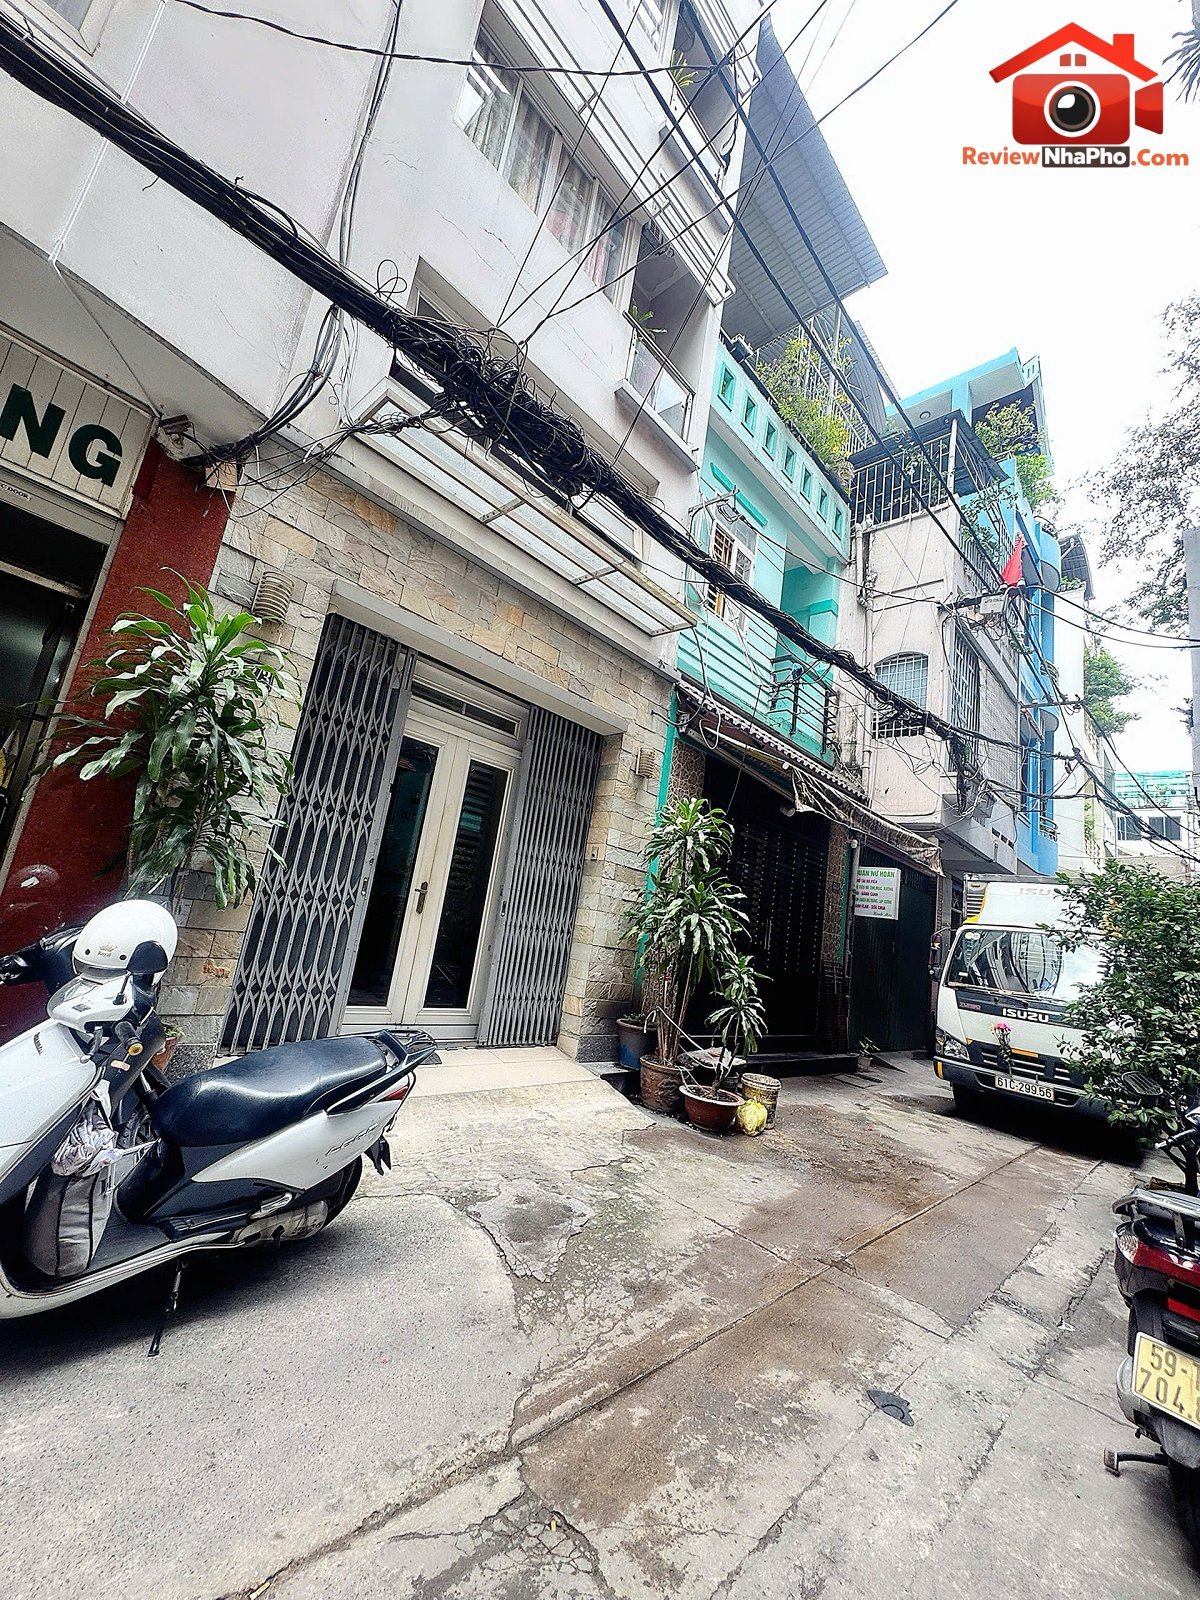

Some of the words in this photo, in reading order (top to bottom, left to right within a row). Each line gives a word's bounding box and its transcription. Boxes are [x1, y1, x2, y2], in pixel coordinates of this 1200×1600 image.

[0, 383, 123, 487] NG
[7, 486, 29, 499] DOOR
[1019, 887, 1053, 896] ISU
[1002, 1007, 1049, 1023] ISUZU
[996, 1076, 1053, 1099] 61C-299.56
